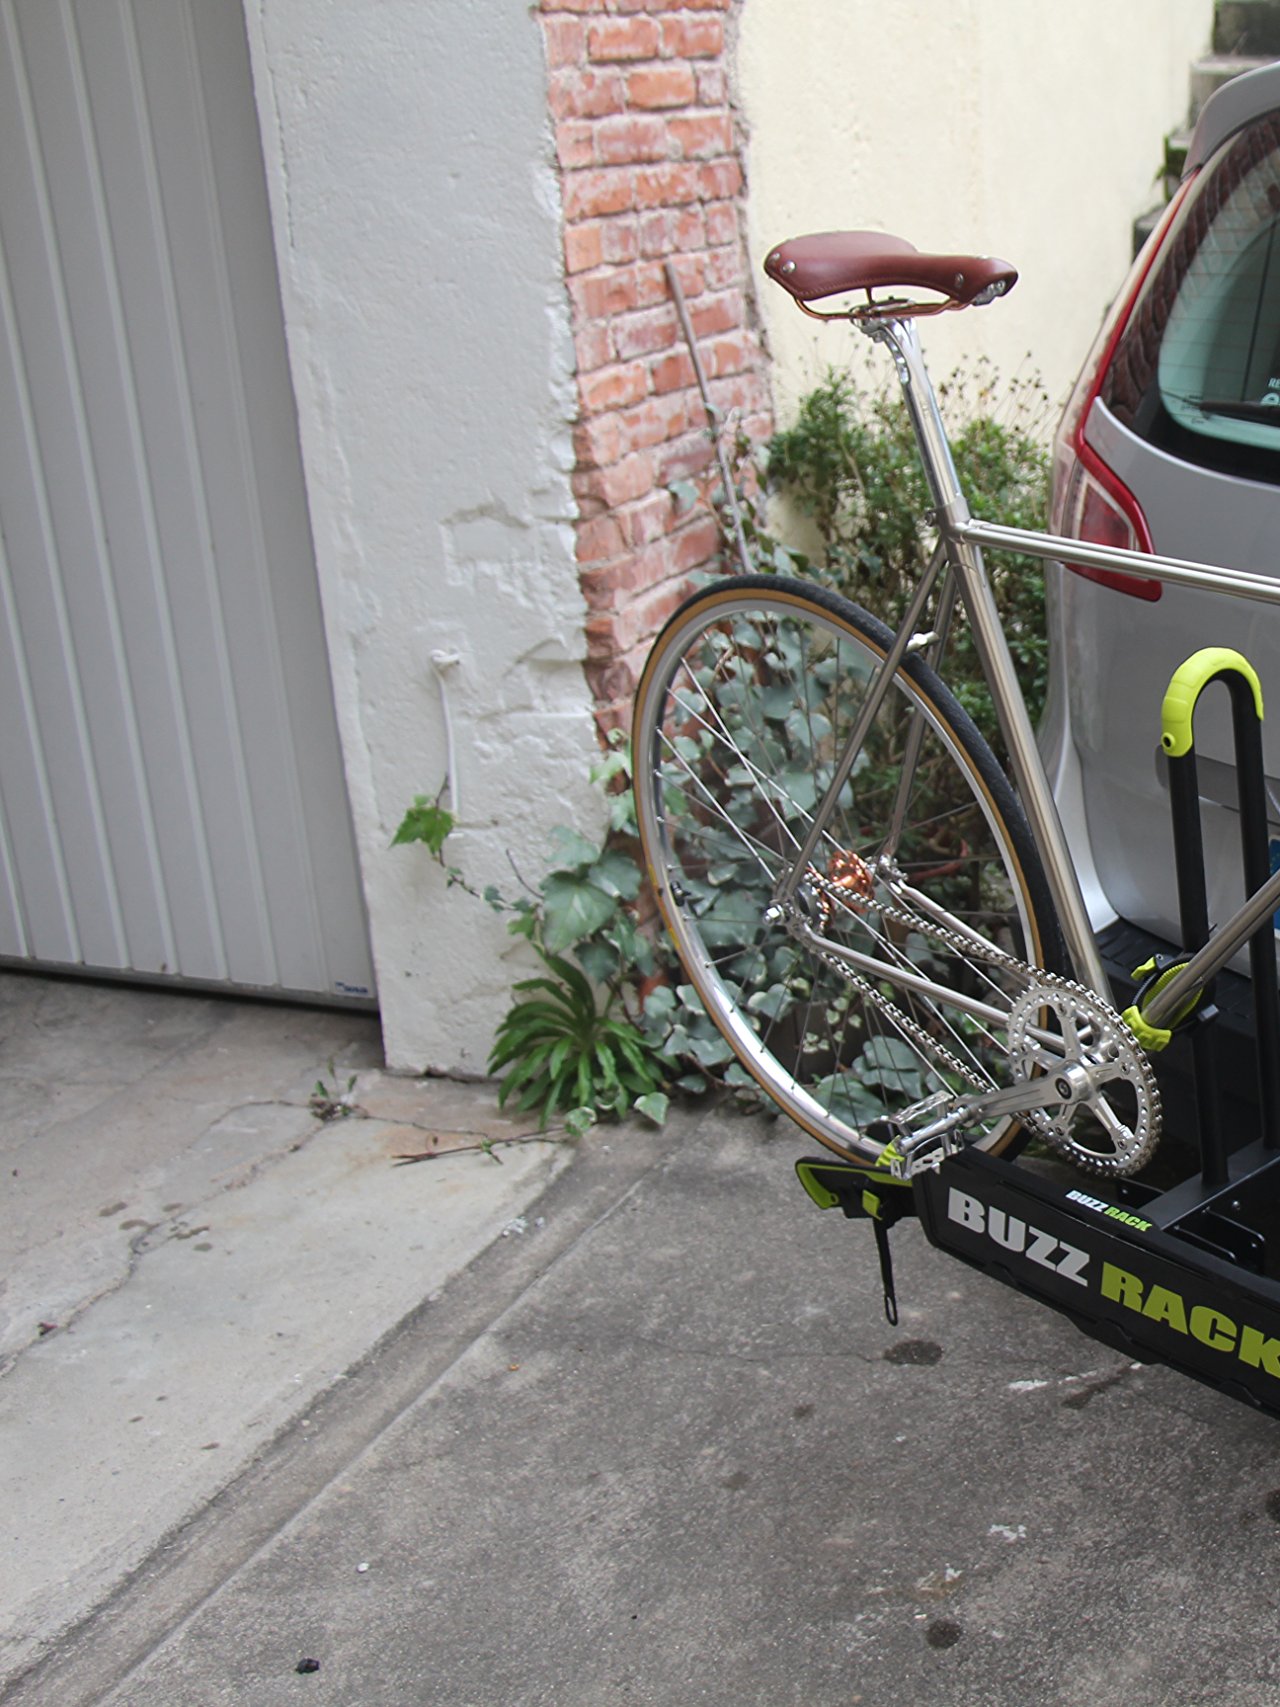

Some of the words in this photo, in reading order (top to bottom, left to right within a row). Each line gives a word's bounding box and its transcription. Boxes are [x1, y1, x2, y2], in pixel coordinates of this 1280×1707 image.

[947, 1186, 1091, 1287] BUZZ
[1065, 1190, 1115, 1214] BUZZ
[1107, 1208, 1153, 1233] RACK
